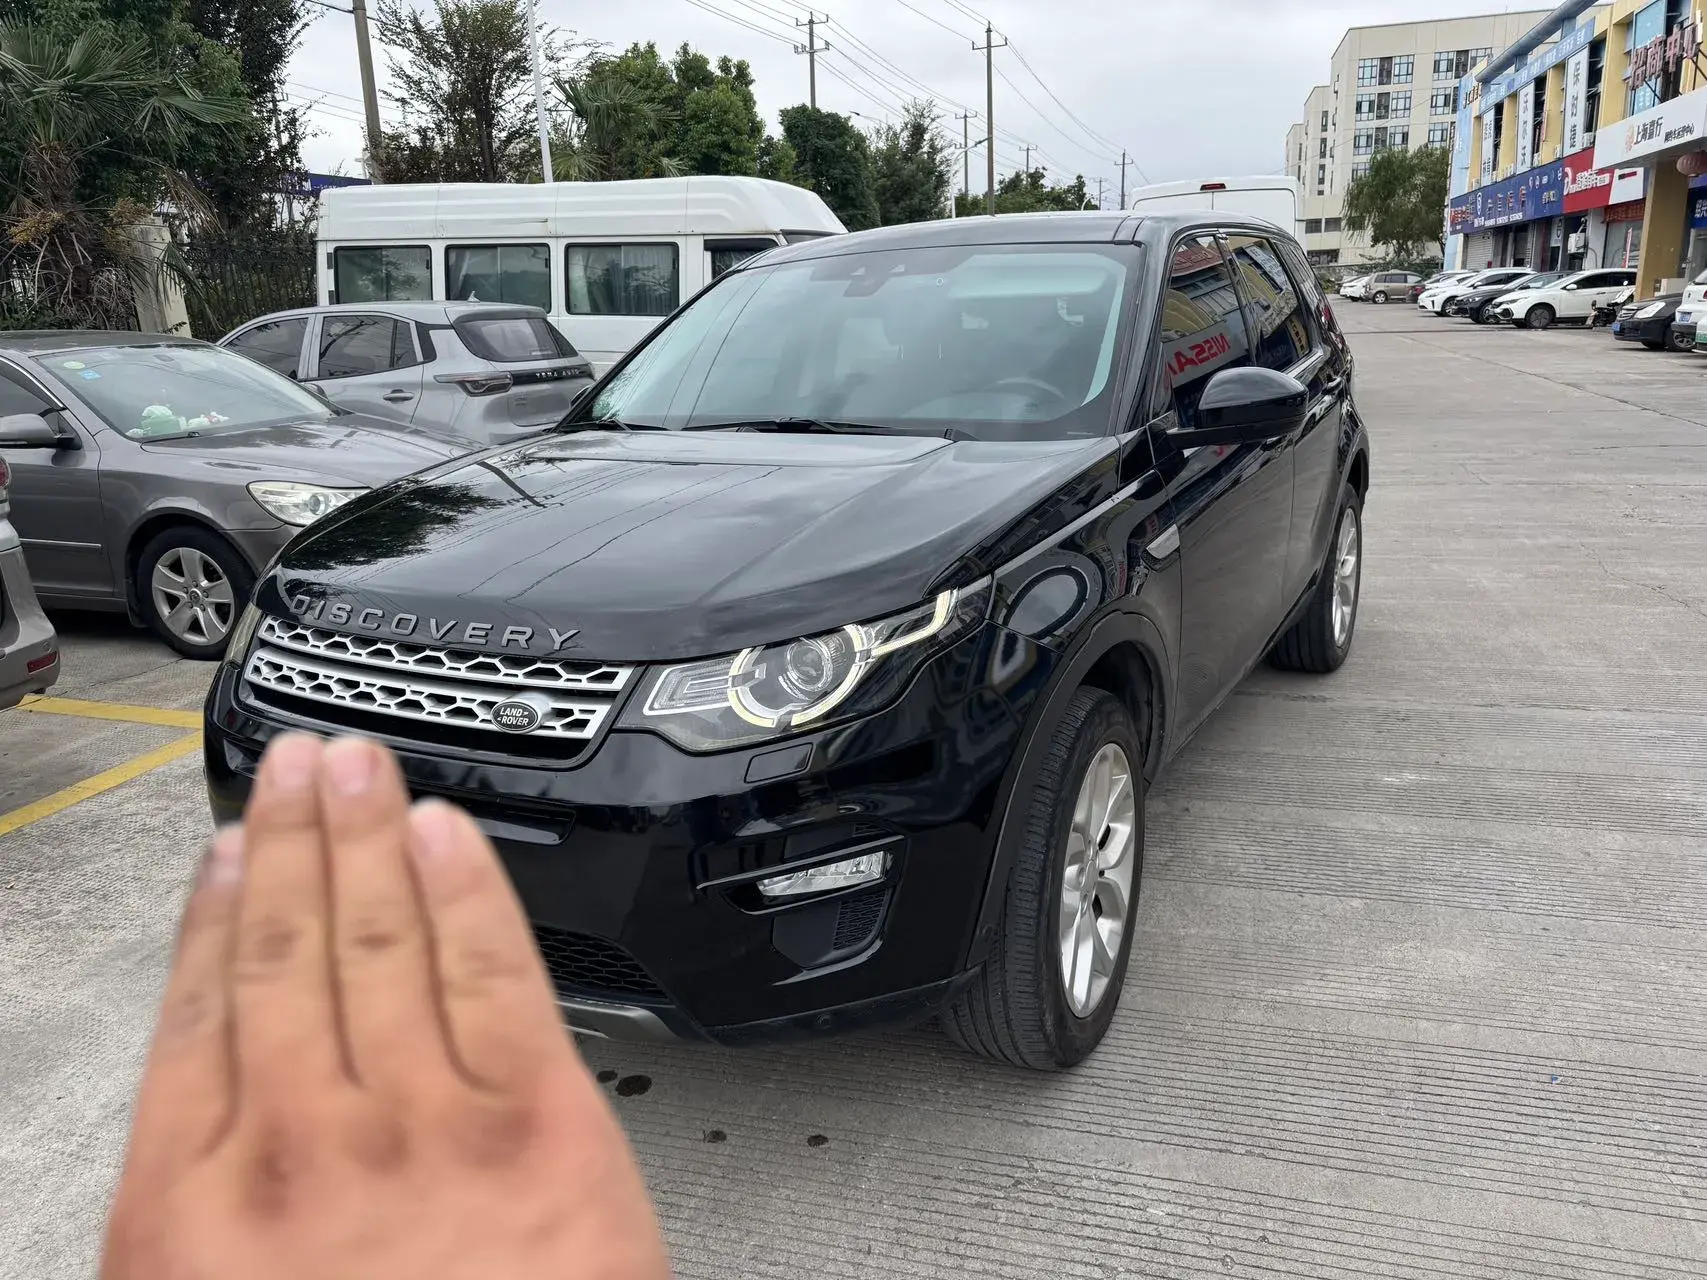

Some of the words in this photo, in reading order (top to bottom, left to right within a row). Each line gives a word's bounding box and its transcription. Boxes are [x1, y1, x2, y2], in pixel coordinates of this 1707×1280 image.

[1630, 14, 1703, 90] 招商中心
[289, 594, 581, 650] DISCOVERY
[500, 706, 523, 717] LAND
[501, 715, 529, 726] ROVER
